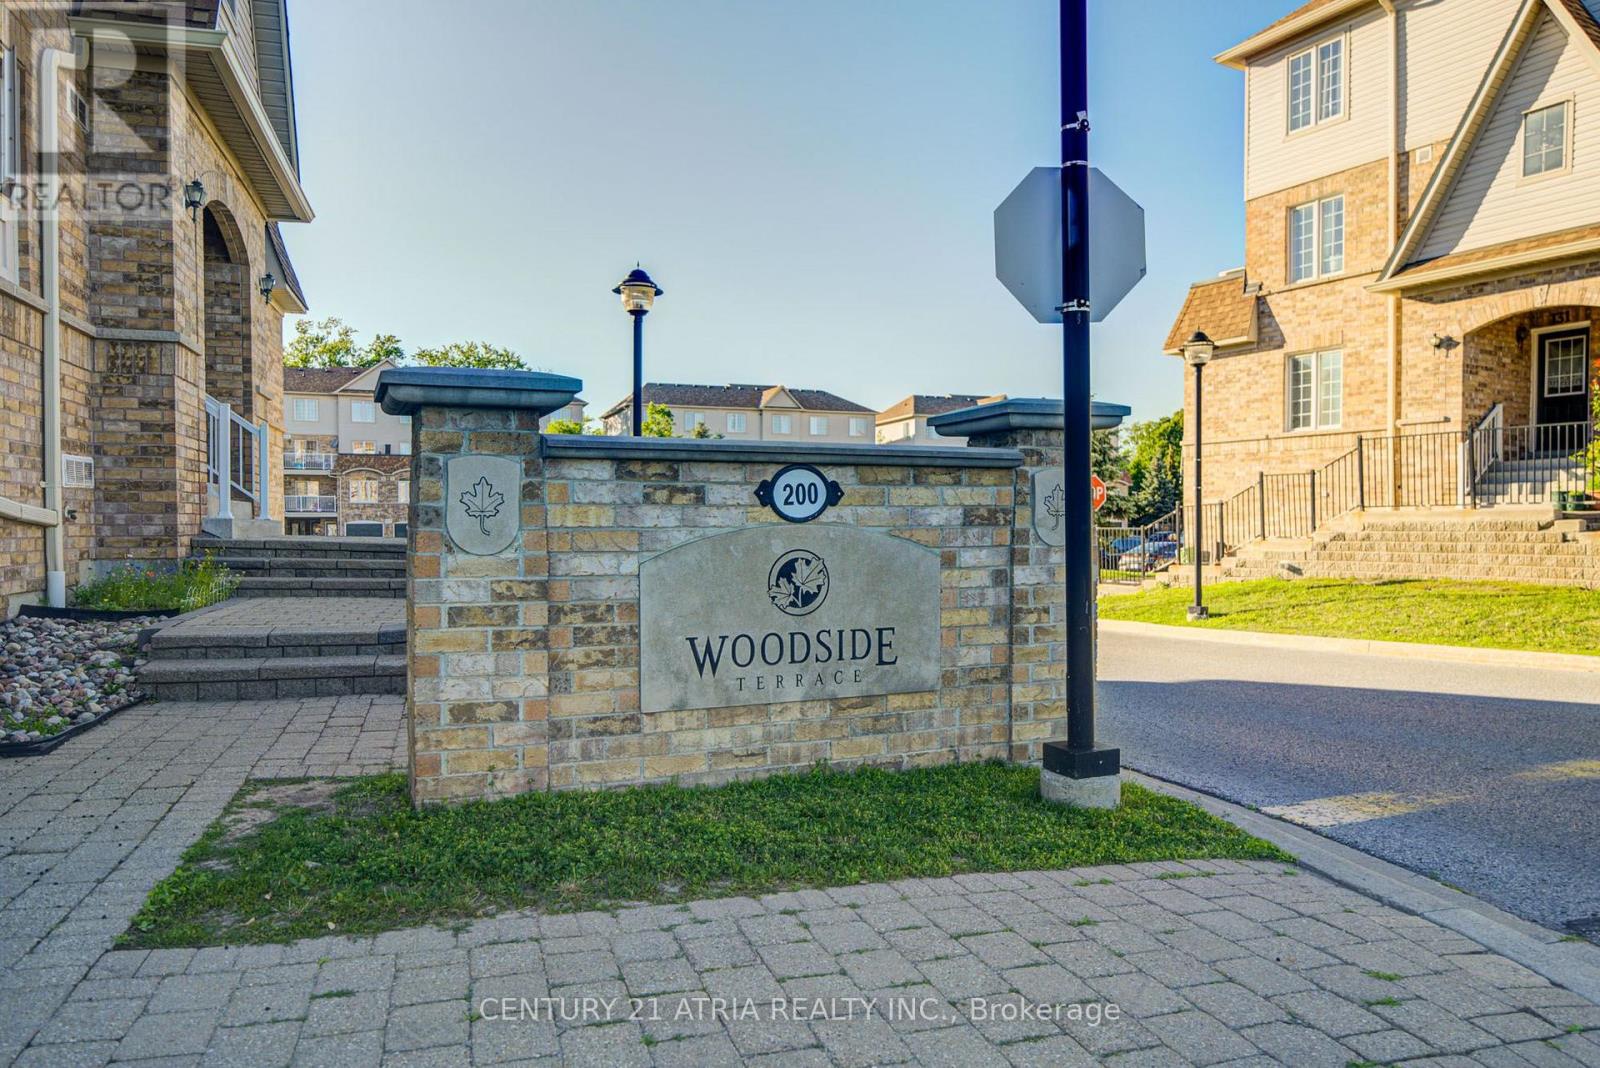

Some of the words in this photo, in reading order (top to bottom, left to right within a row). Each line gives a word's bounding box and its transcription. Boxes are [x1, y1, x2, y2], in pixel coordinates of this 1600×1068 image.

[782, 482, 819, 506] 200
[686, 626, 898, 680] WOODSIDE
[736, 669, 862, 691] TERRACE
